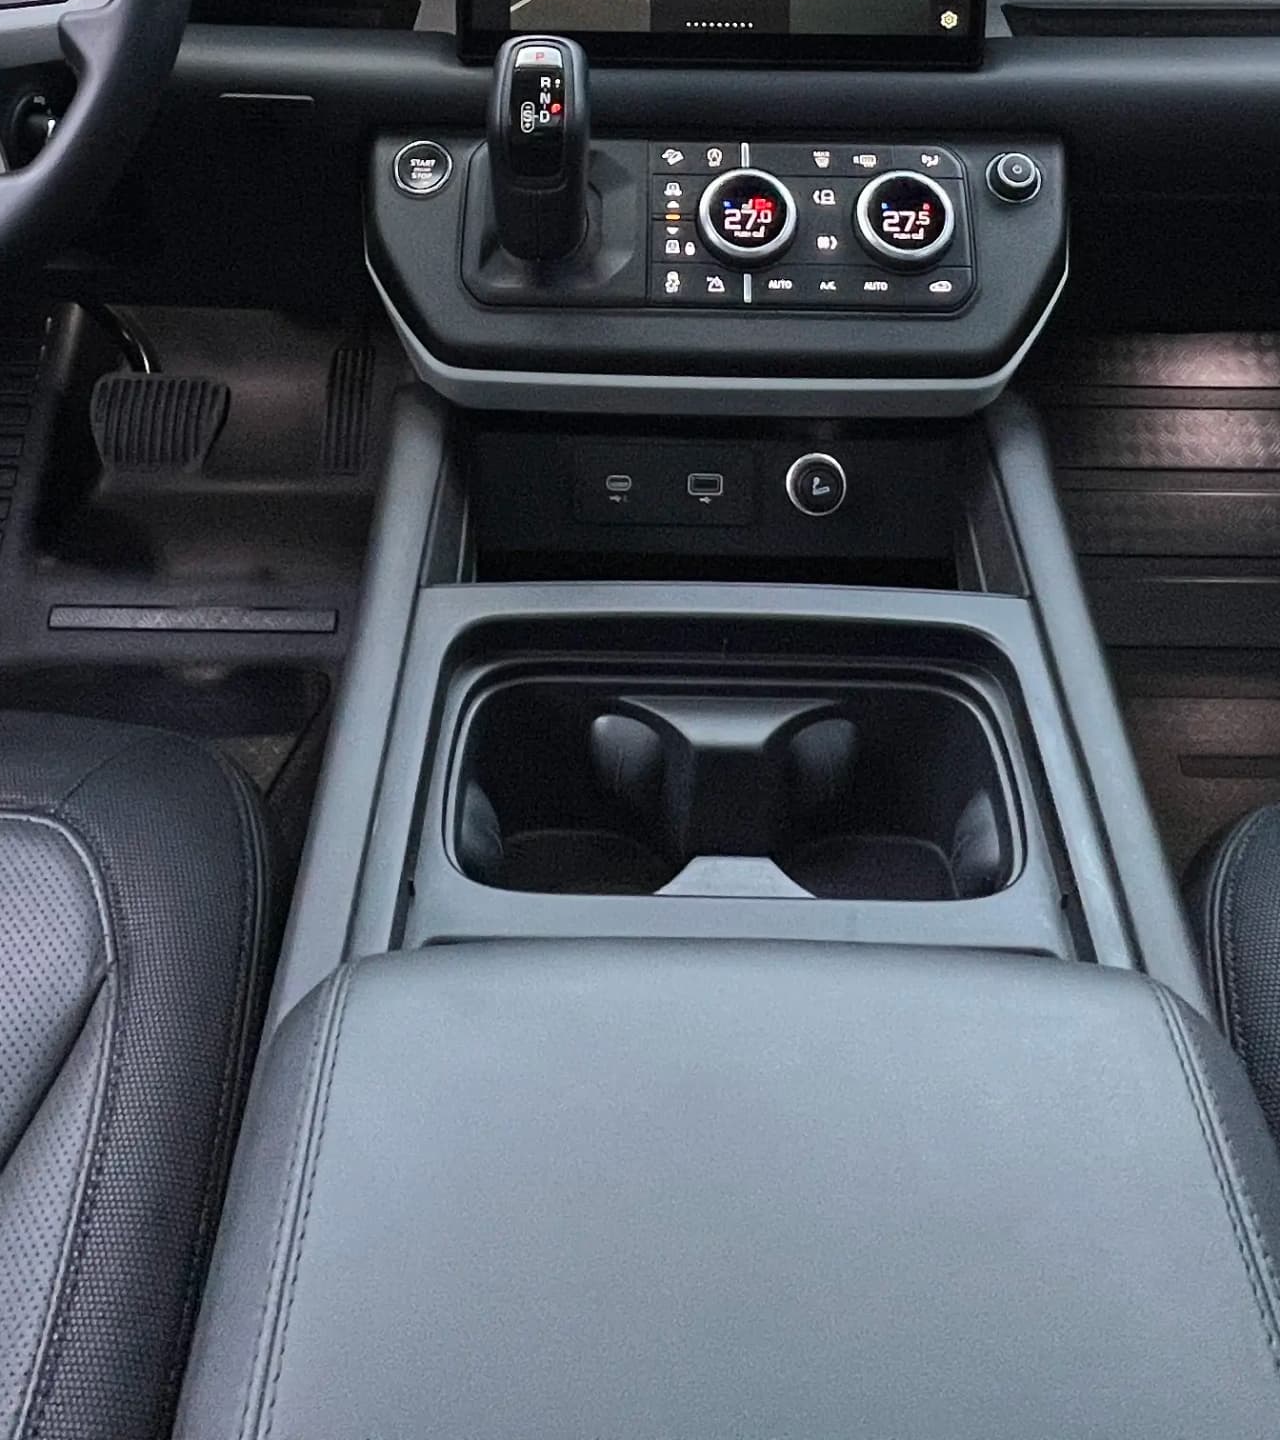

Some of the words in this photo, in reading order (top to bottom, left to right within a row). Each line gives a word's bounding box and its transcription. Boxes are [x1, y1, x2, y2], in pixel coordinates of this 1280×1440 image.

[540, 76, 551, 89] R
[540, 92, 551, 104] N
[540, 110, 550, 123] D
[410, 158, 436, 167] START
[724, 209, 772, 230] 27.0
[882, 210, 930, 232] 27.5
[768, 279, 793, 289] AUTO
[863, 281, 889, 291] AUTO
